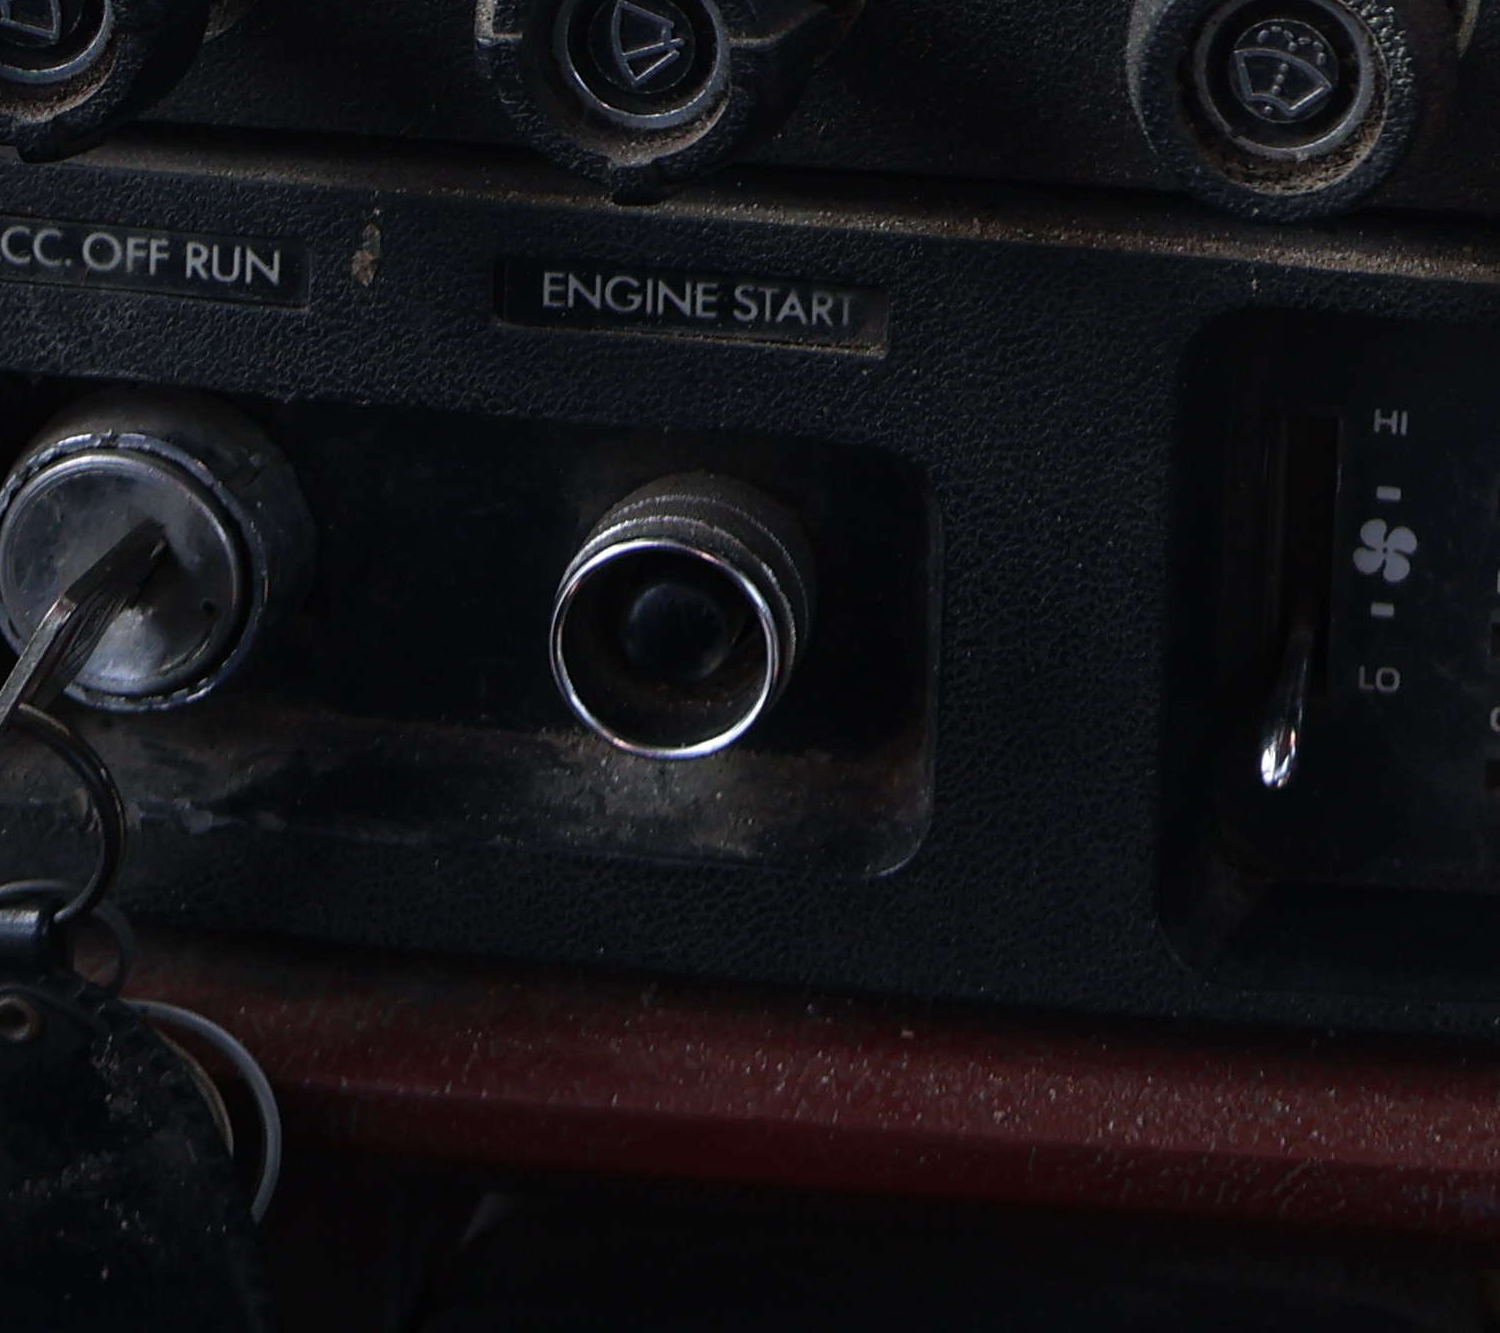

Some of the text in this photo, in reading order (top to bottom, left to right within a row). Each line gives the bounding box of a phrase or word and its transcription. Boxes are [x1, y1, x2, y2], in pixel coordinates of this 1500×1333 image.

[81, 231, 170, 276] OFF
[185, 240, 282, 287] RUN
[542, 270, 857, 327] ENGINE START
[1373, 408, 1409, 437] HI
[1358, 664, 1401, 694] LO
